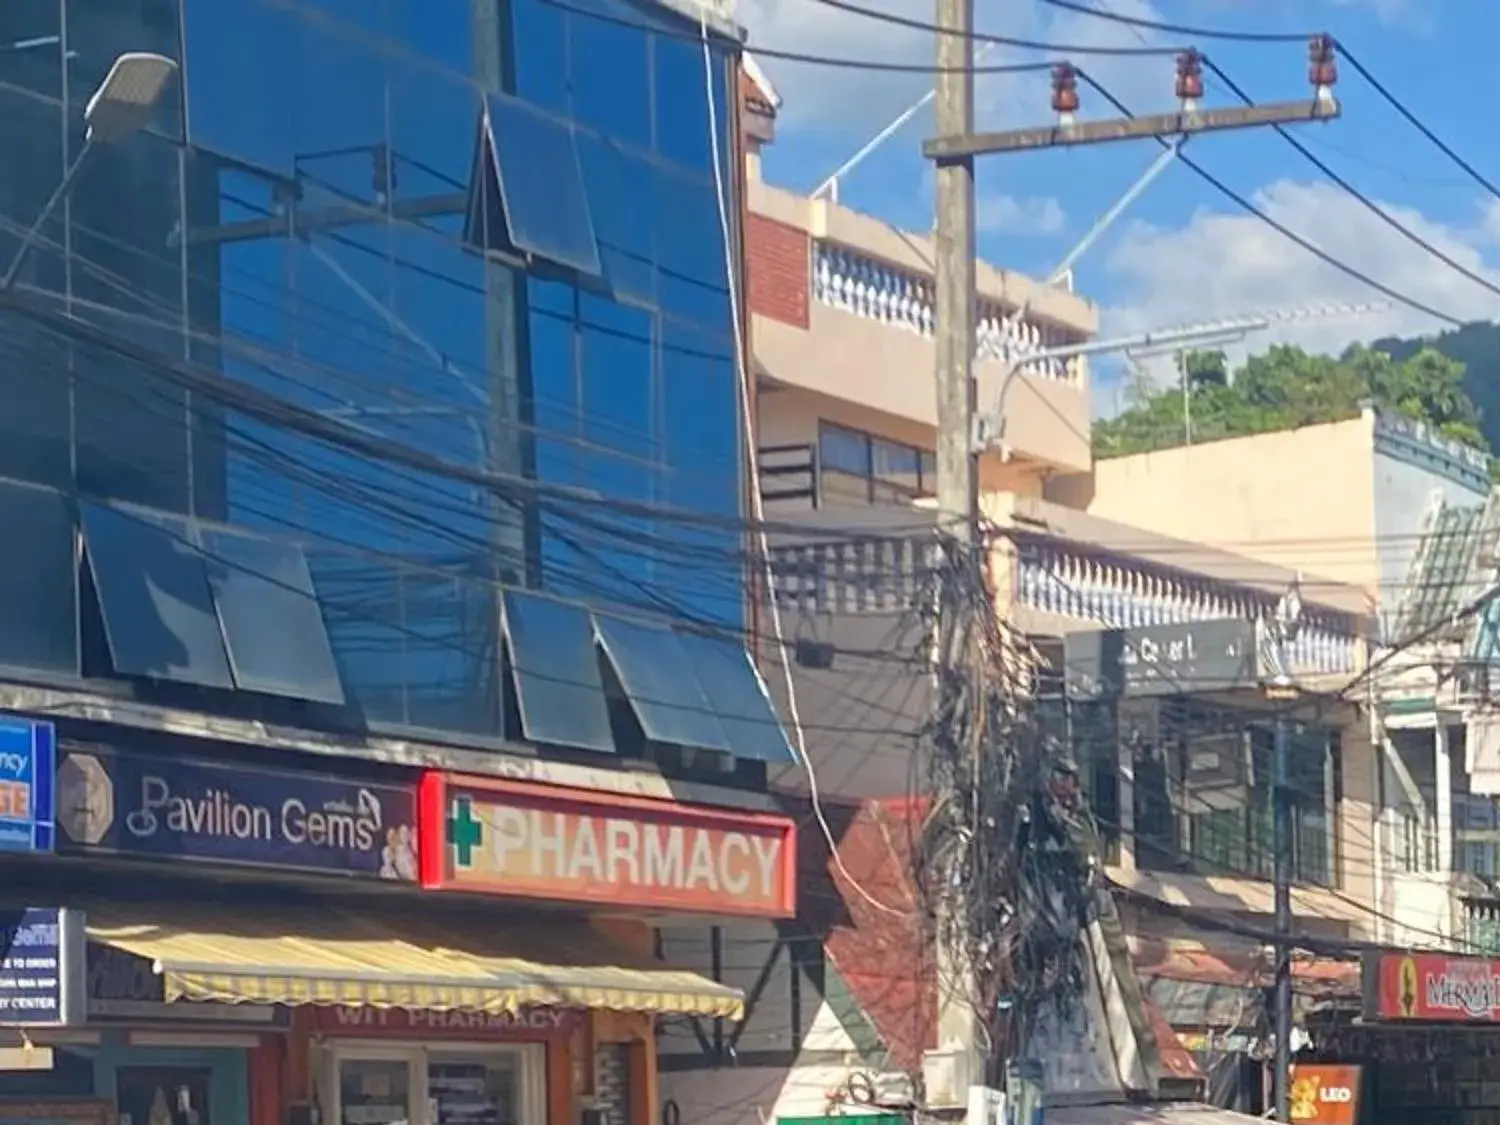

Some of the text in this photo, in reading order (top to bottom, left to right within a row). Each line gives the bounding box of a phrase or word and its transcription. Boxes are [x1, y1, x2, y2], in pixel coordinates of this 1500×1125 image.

[126, 777, 374, 851] Pavilion Gems
[494, 808, 782, 897] PHARMACY
[1319, 1087, 1352, 1103] LEO
